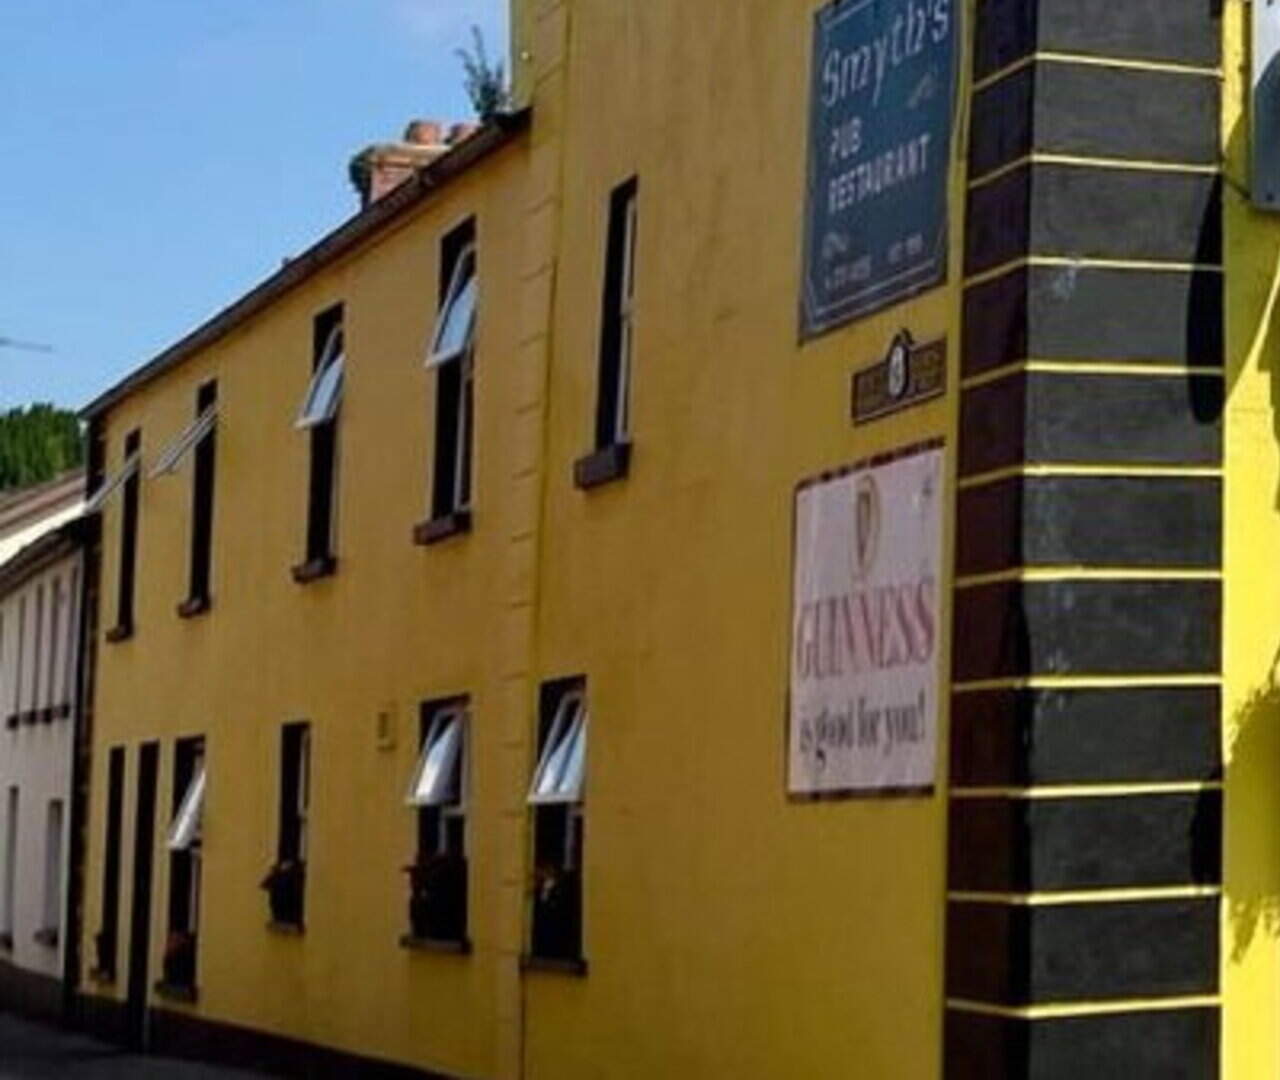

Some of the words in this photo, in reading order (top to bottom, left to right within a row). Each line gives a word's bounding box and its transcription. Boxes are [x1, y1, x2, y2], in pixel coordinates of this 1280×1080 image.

[828, 133, 931, 214] RESTAURANT
[829, 116, 863, 164] PUB
[797, 580, 935, 680] GUINNESS
